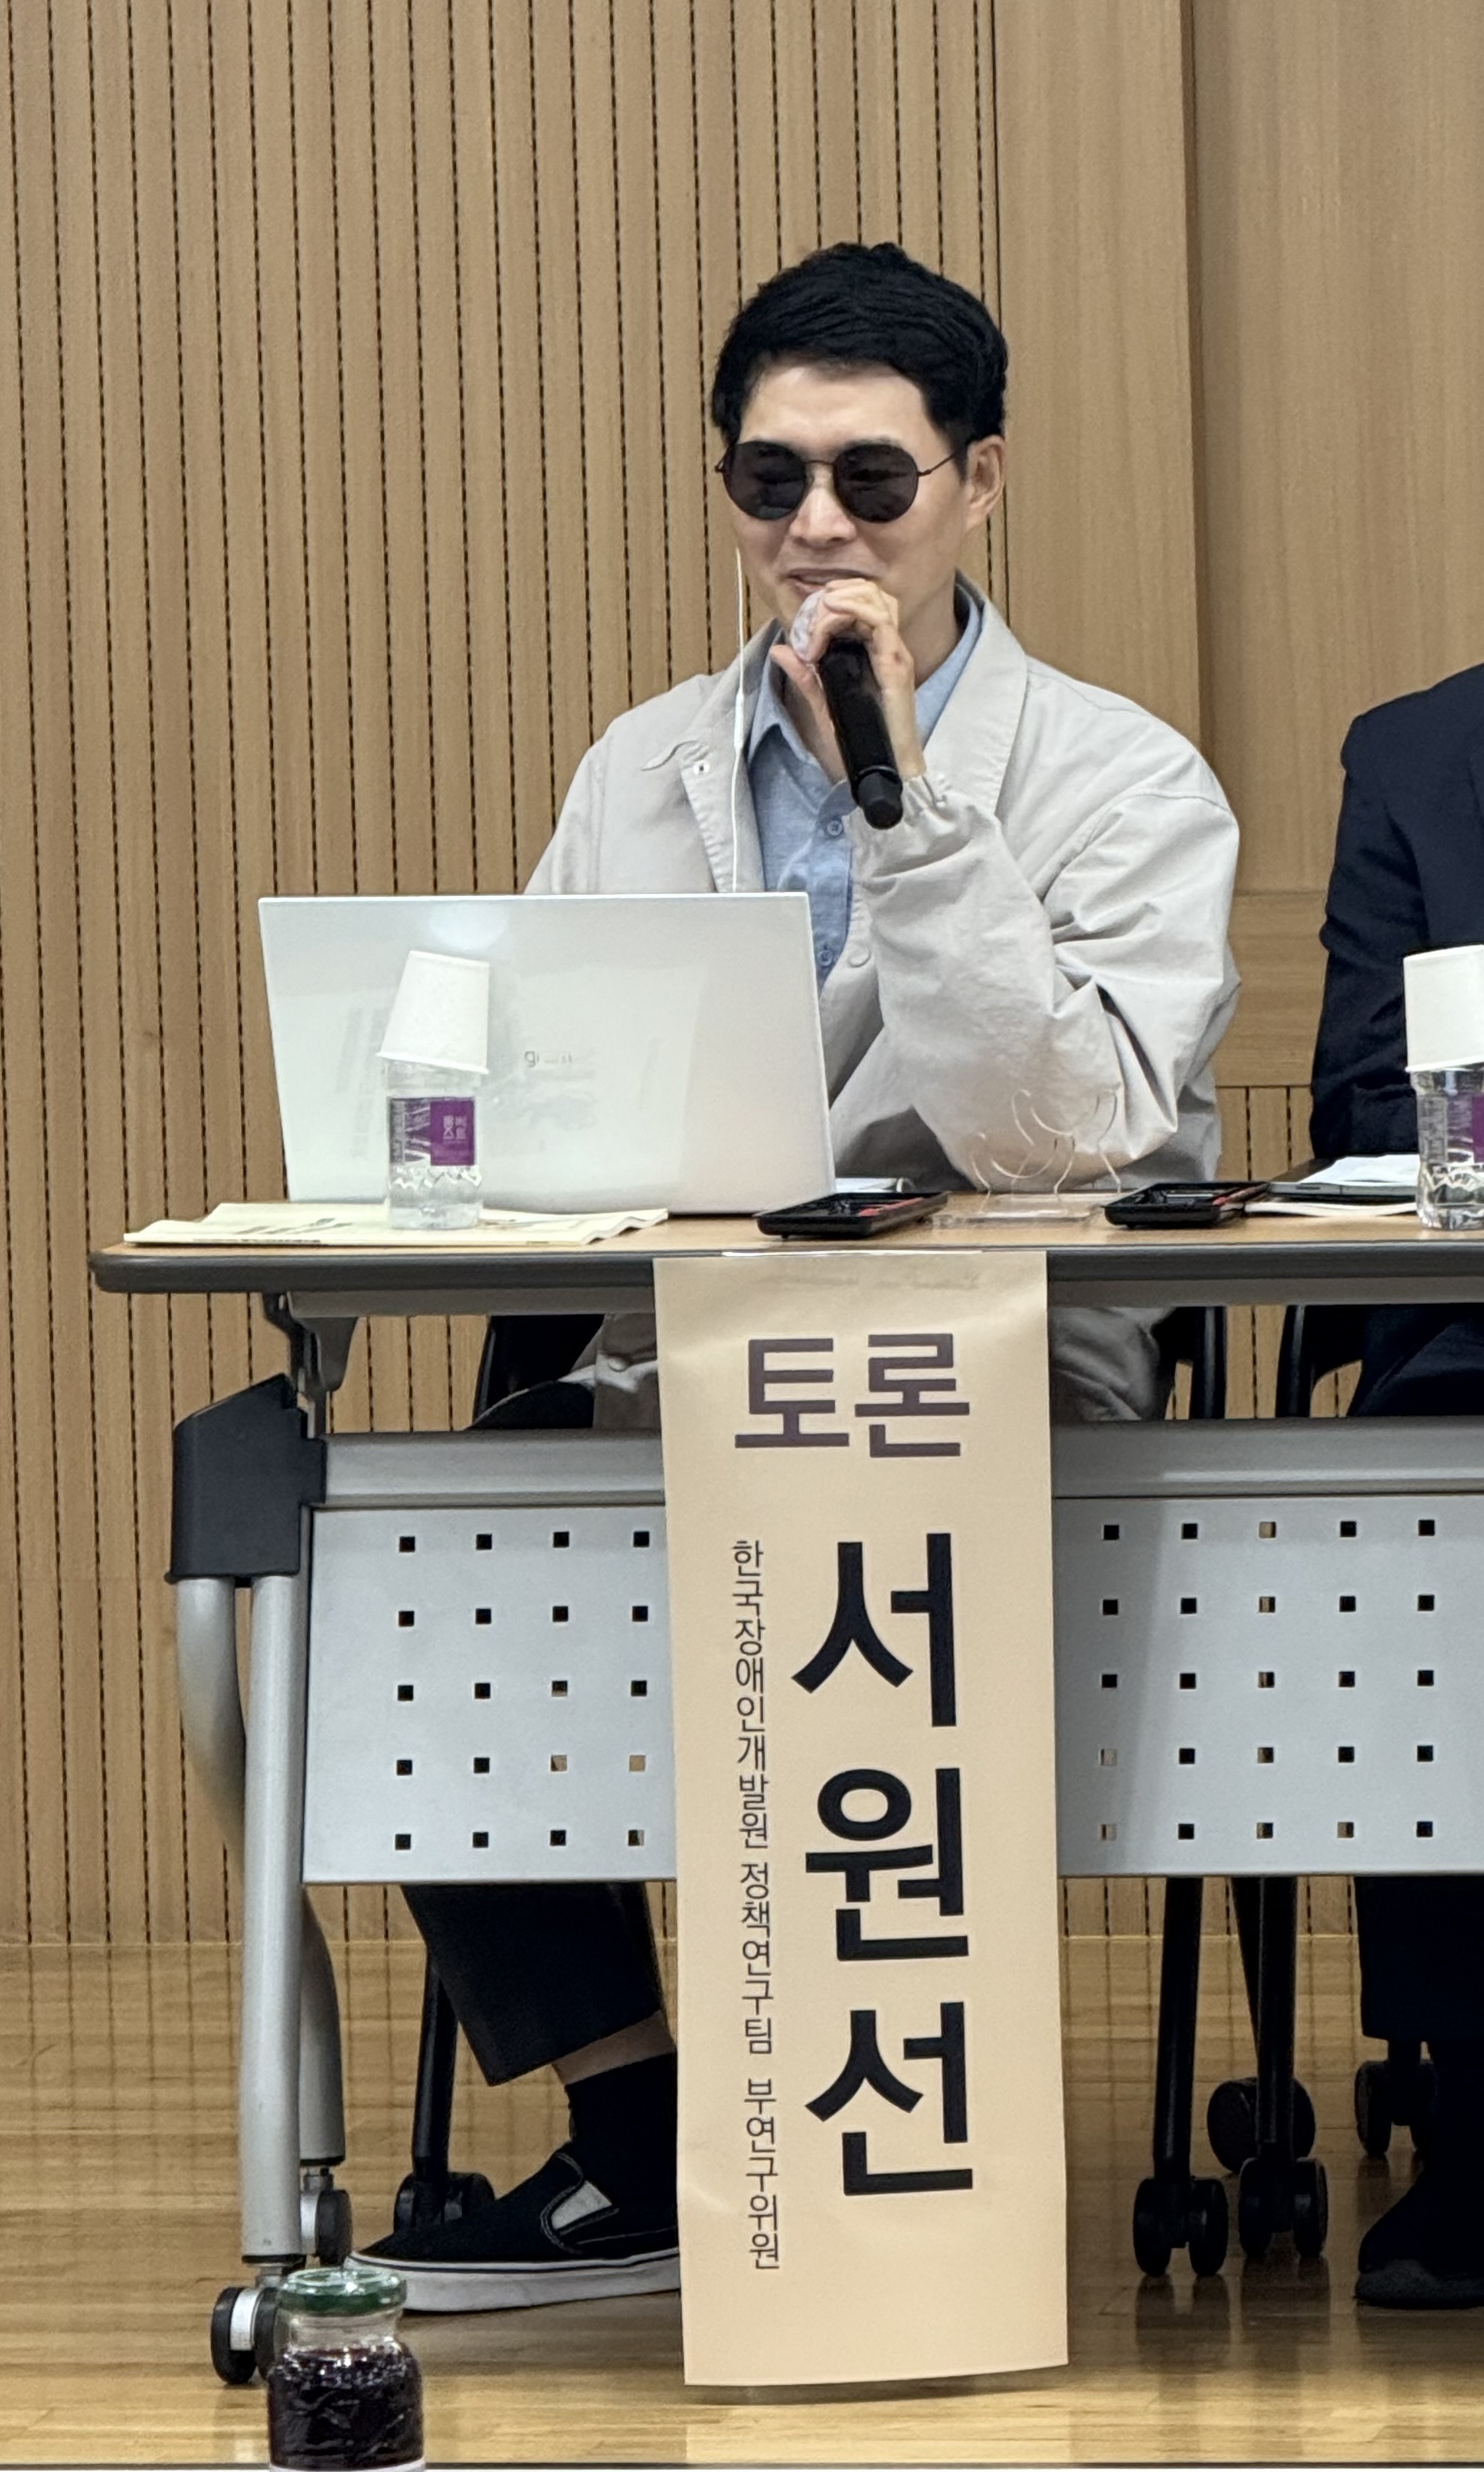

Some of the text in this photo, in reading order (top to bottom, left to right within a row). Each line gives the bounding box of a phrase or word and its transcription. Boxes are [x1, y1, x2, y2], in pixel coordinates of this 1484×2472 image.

[734, 1334, 970, 1458] 토론
[731, 1539, 780, 2270] 한국장애인개발원 정책연구팀 부연구위원
[792, 1533, 973, 2197] 서원선
